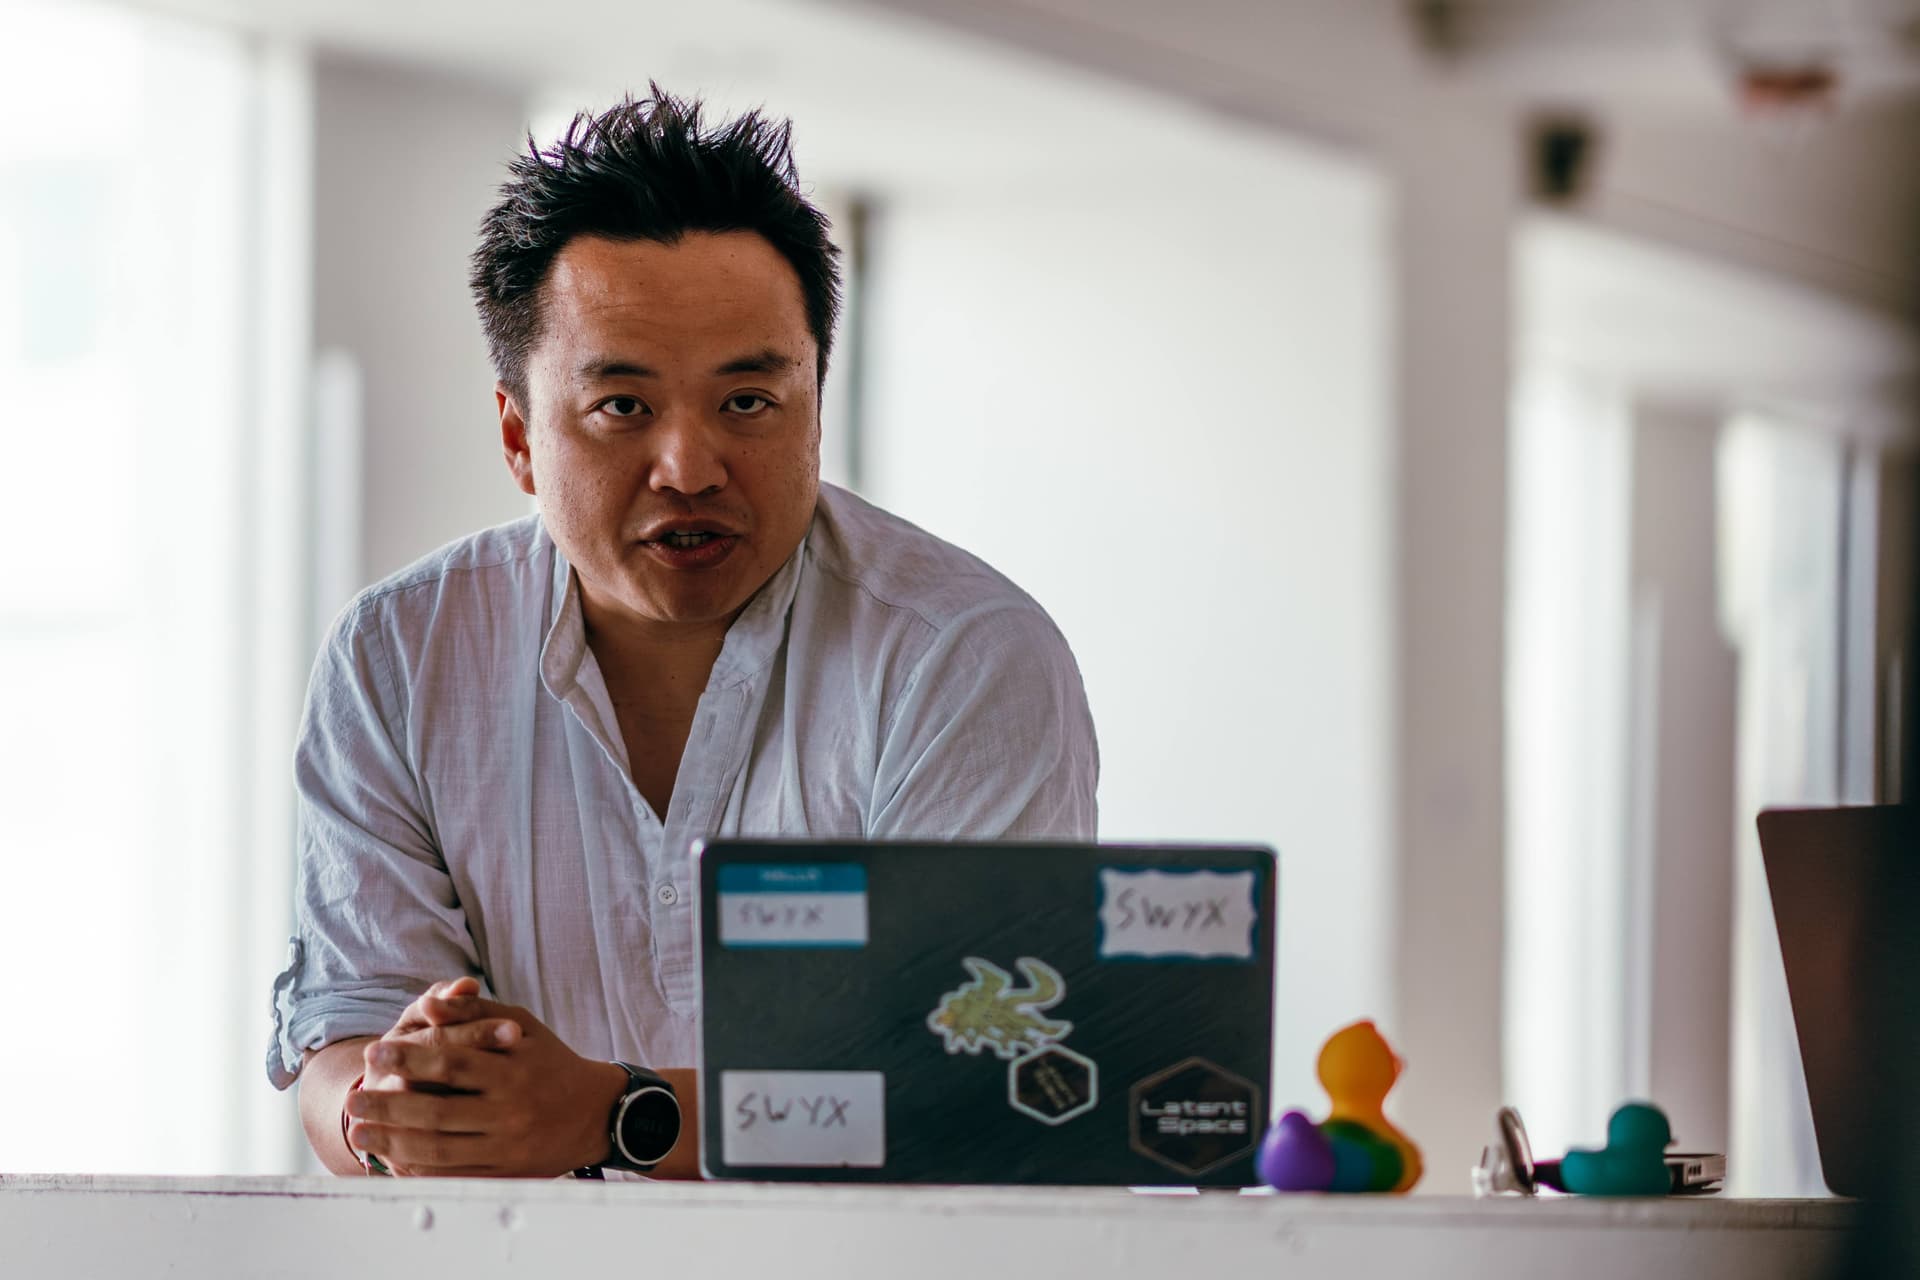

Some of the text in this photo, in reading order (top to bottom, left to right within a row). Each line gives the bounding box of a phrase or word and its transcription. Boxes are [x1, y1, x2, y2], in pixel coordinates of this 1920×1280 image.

[1117, 888, 1229, 932] SWYX
[737, 1092, 851, 1132] SWYX
[1140, 1099, 1247, 1117] Latent
[1157, 1116, 1247, 1136] Space
